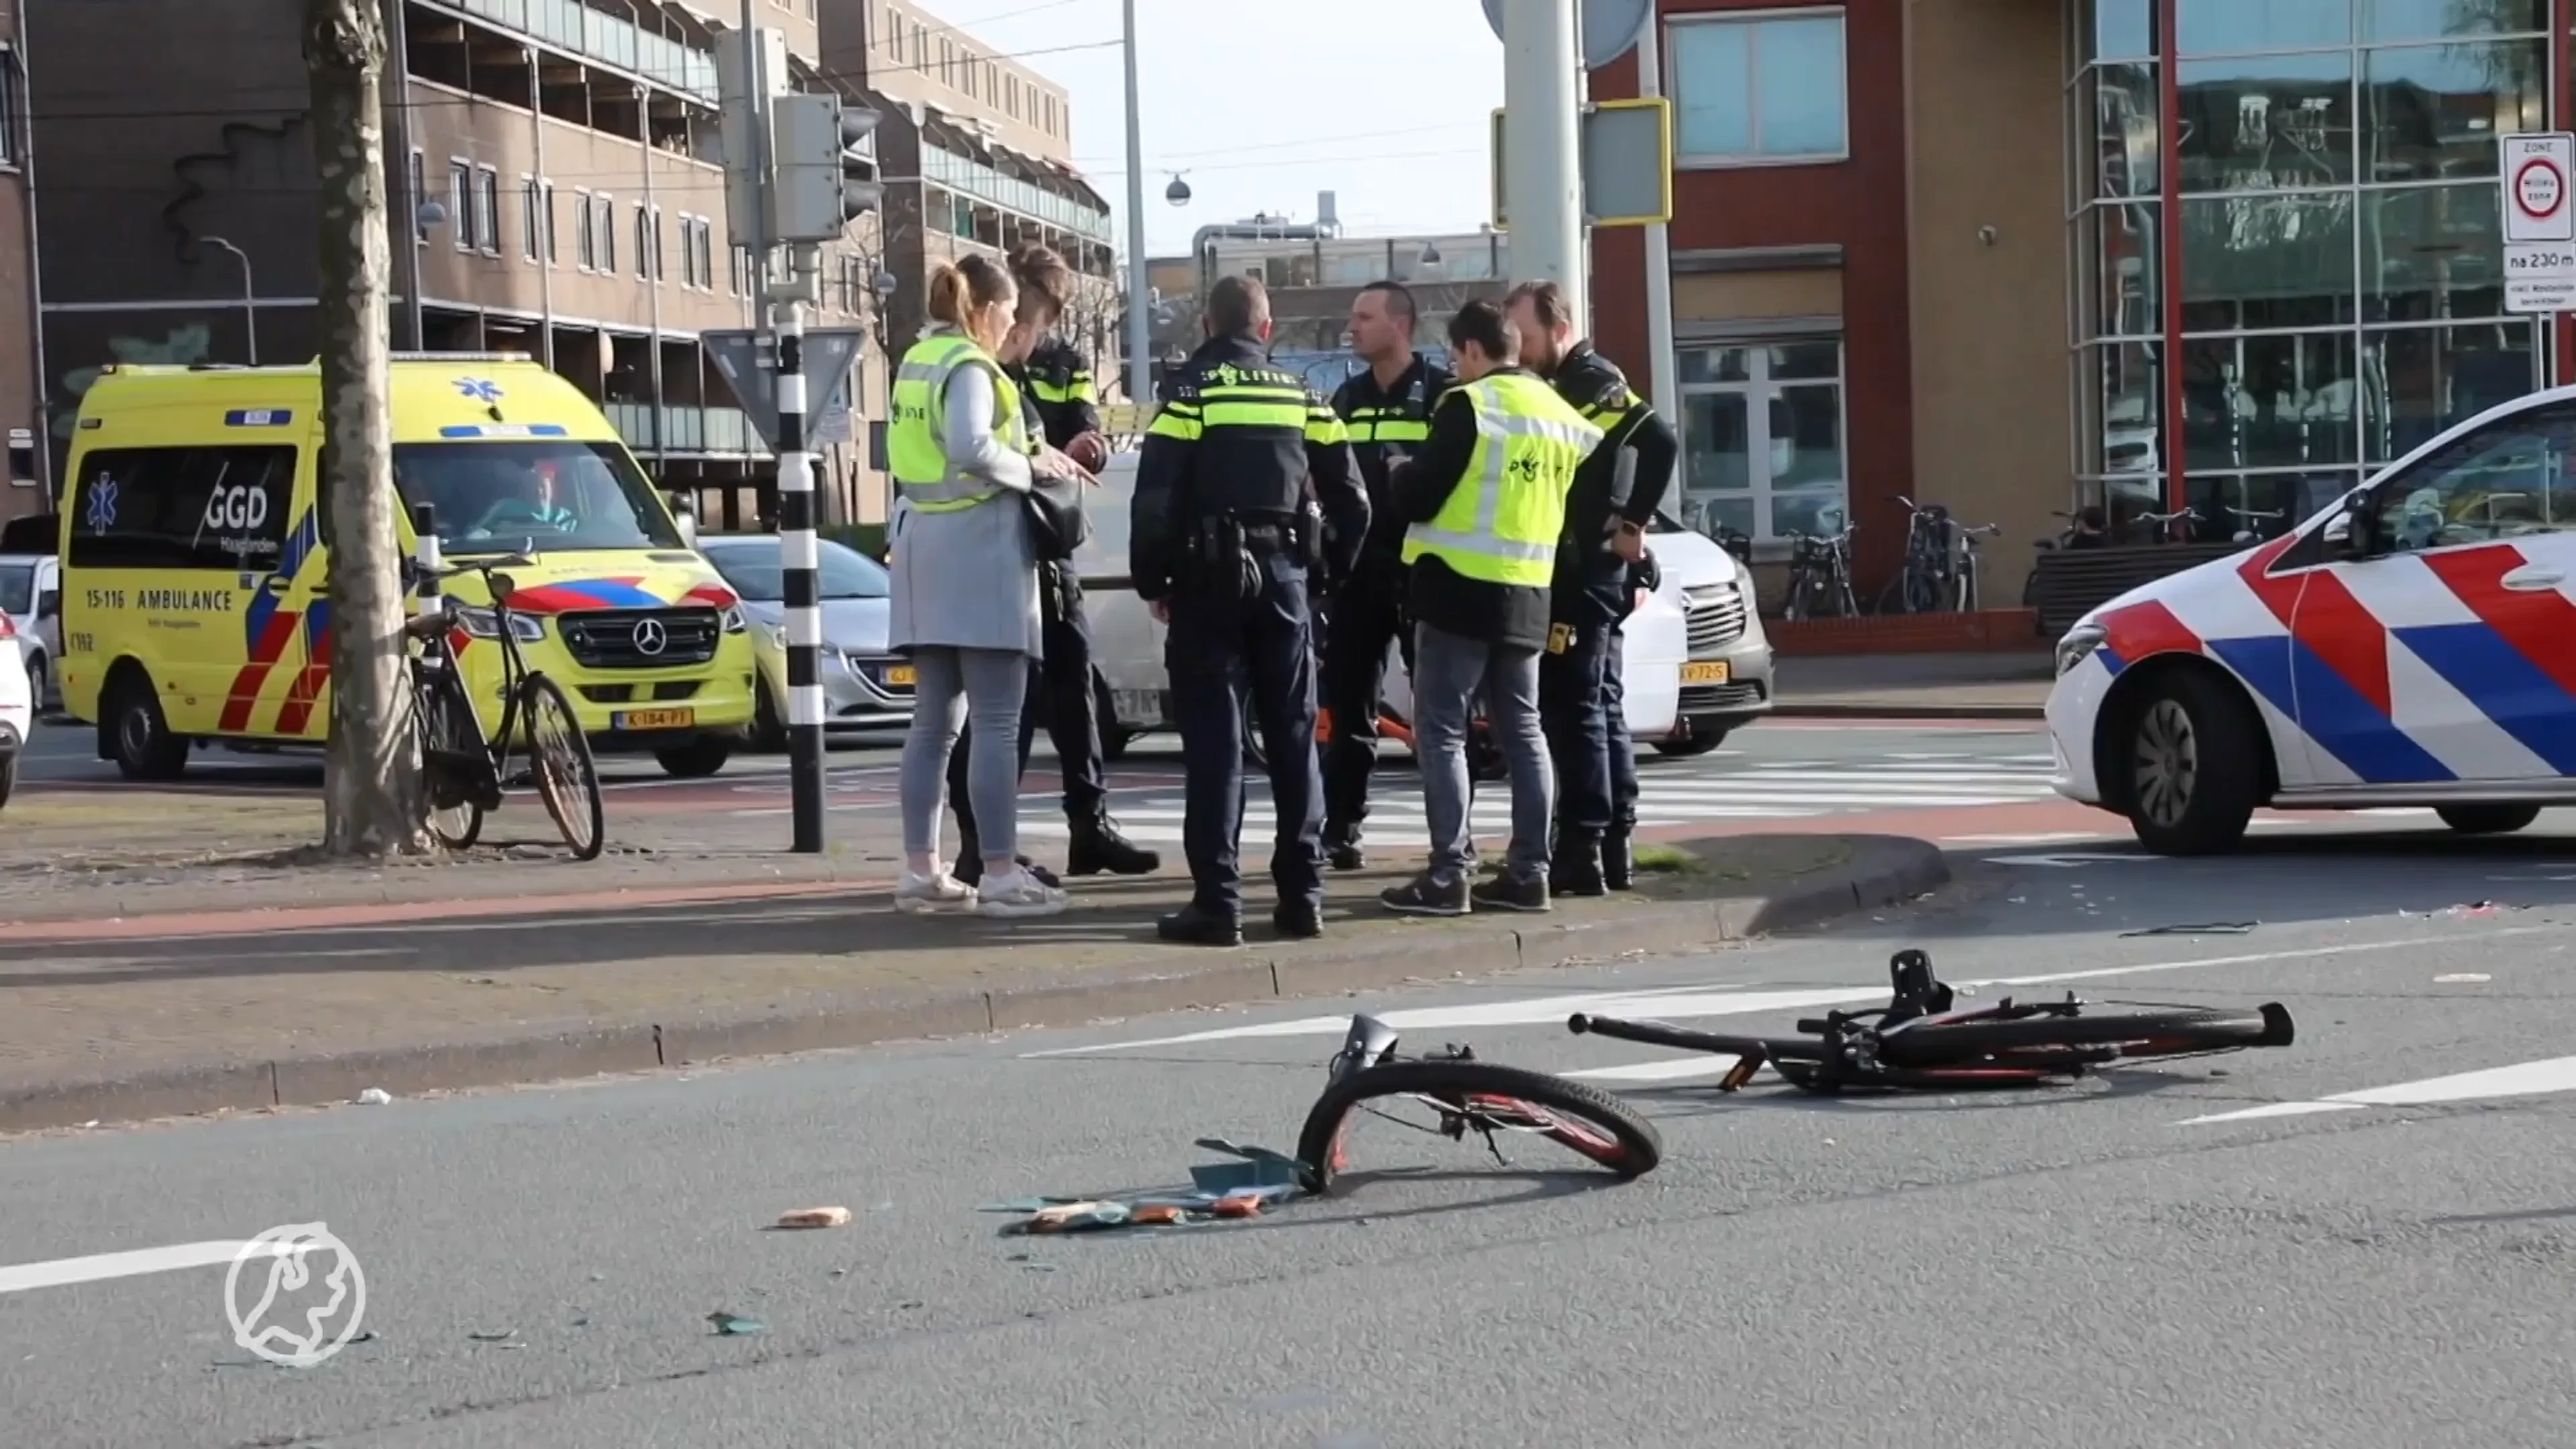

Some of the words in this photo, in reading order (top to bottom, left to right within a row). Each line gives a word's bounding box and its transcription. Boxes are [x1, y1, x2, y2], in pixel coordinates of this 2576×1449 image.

[2524, 142, 2553, 153] ZONE
[2510, 257, 2526, 268] na
[2530, 252, 2559, 268] 230
[2561, 256, 2573, 266] m
[206, 486, 267, 529] GGD
[137, 589, 232, 611] AMBULANCE
